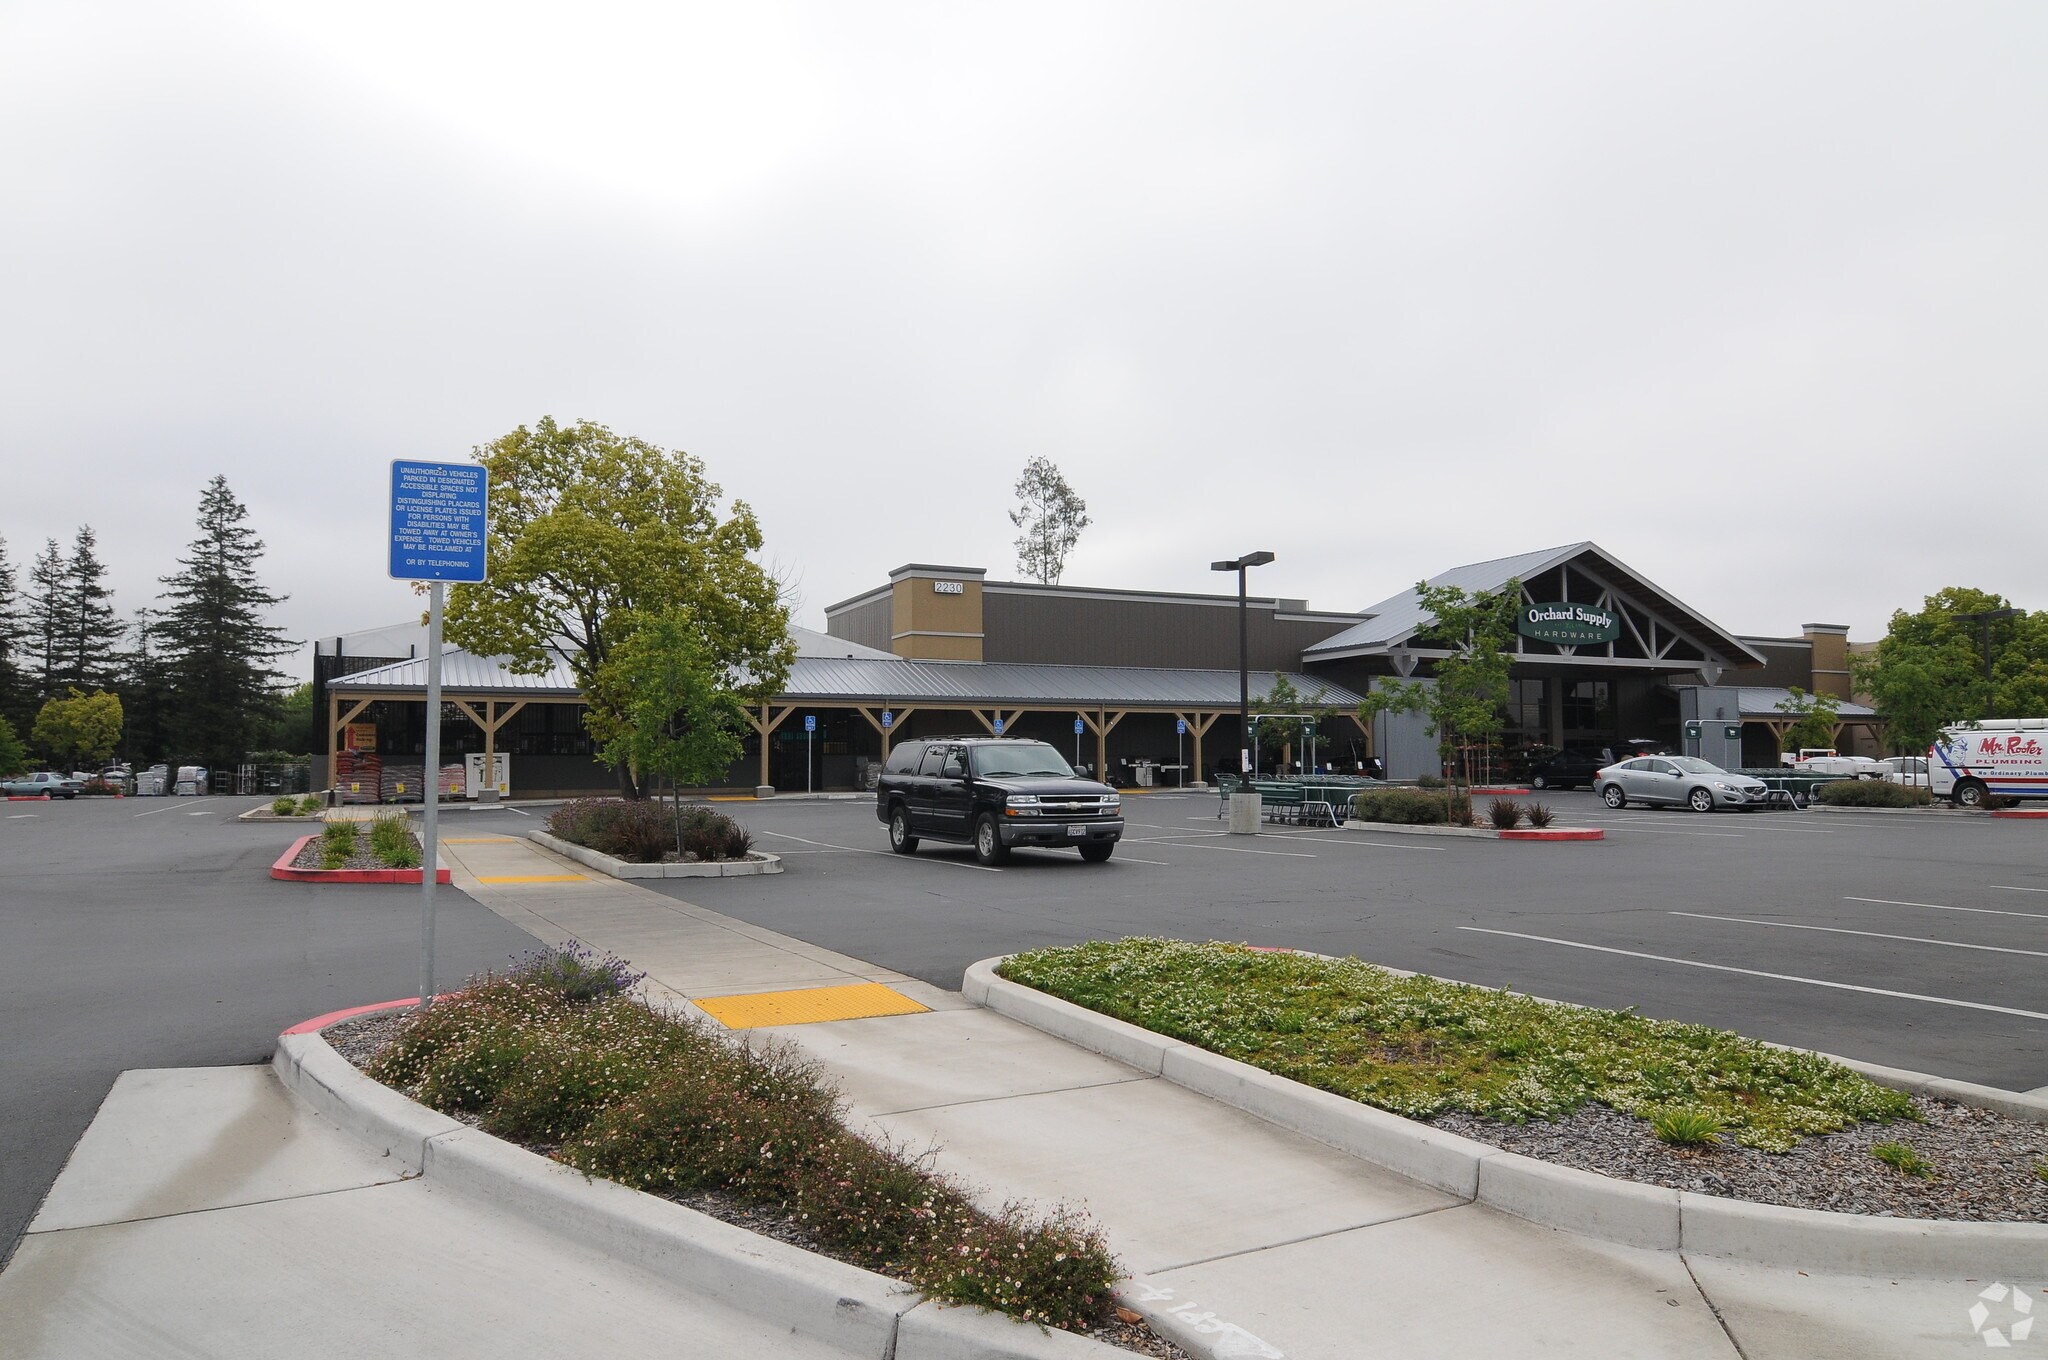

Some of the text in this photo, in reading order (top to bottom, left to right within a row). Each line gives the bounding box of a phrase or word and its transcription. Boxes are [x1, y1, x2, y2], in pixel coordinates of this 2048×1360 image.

[401, 467, 447, 476] UNAUTHORIZED
[398, 498, 446, 506] DISTINGUISHING
[936, 582, 962, 592] 2230
[1528, 607, 1612, 628] Orchard Supply
[1534, 630, 1602, 640] HARDWARE
[1979, 736, 2042, 756] Mr. Rooter
